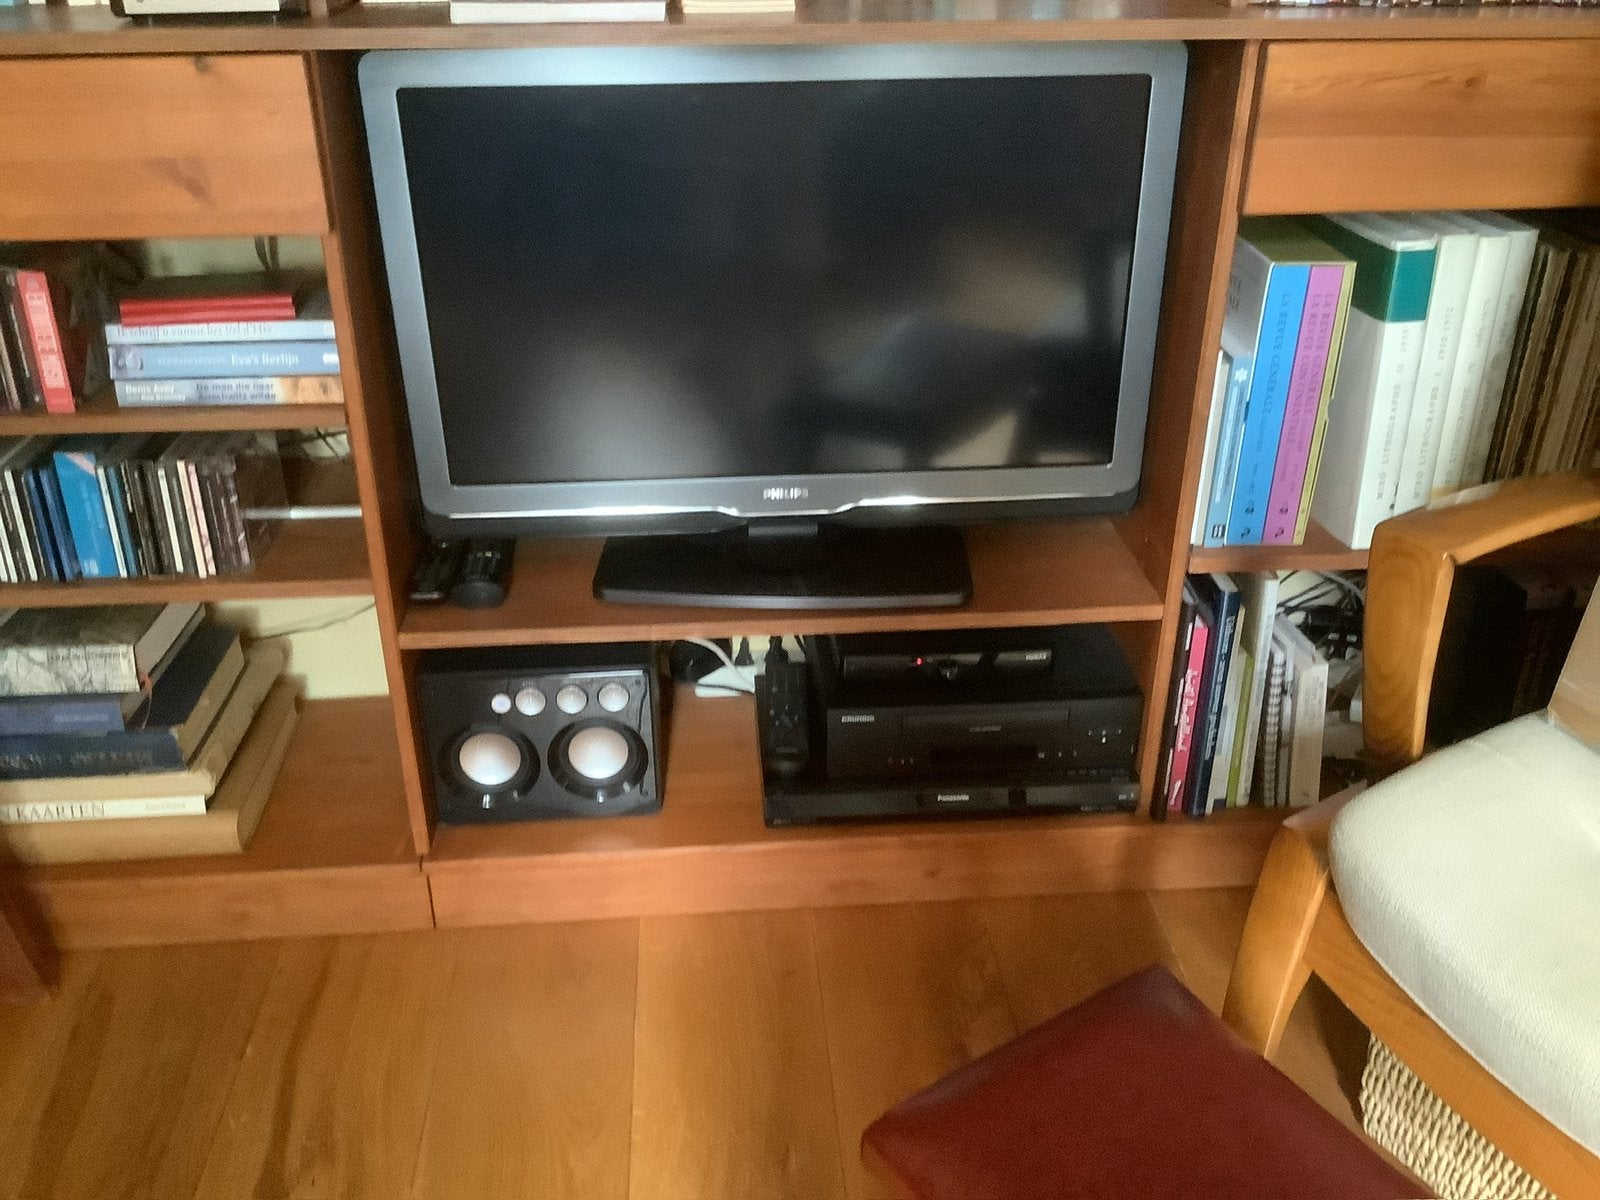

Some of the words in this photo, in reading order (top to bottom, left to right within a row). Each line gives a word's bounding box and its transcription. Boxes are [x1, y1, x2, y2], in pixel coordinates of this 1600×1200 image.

[1272, 311, 1288, 350] REVUE
[1302, 312, 1318, 350] REVUE
[1314, 312, 1330, 349] REVUE
[231, 353, 259, 366] Eva's
[262, 353, 299, 370] Berlijn
[763, 487, 809, 501] PHILIPS
